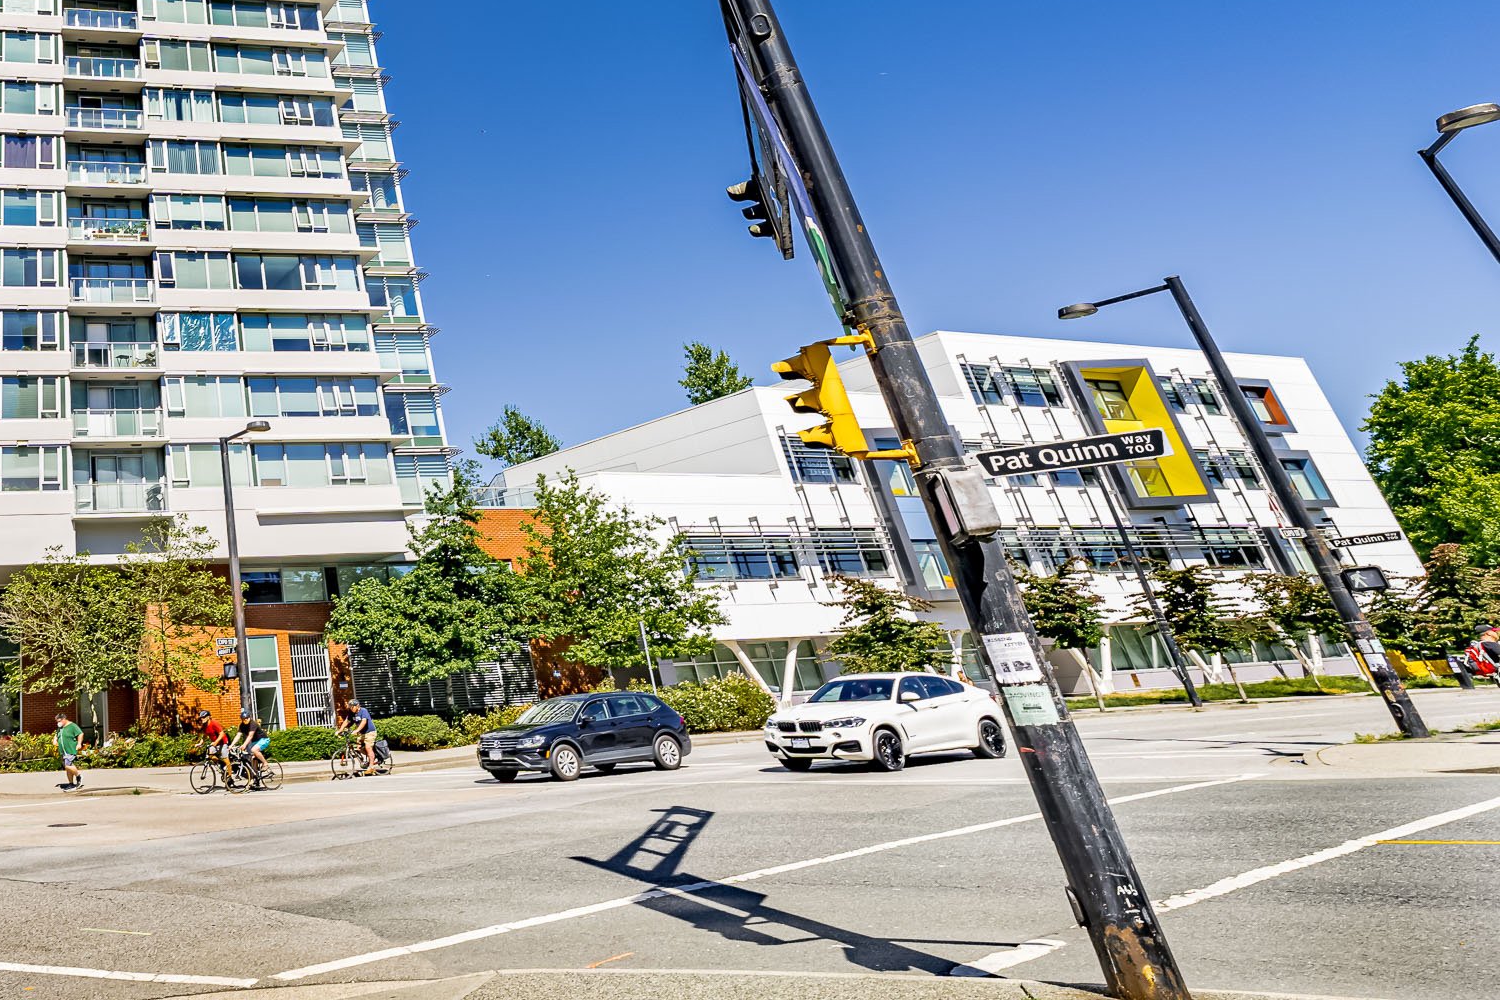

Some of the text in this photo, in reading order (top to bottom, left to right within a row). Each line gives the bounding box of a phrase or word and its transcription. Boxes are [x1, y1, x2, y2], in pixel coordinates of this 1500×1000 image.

[1120, 433, 1151, 445] Way
[1125, 443, 1155, 454] 700
[988, 441, 1118, 472] Pat Quinn
[1334, 534, 1385, 547] Pat Quinn
